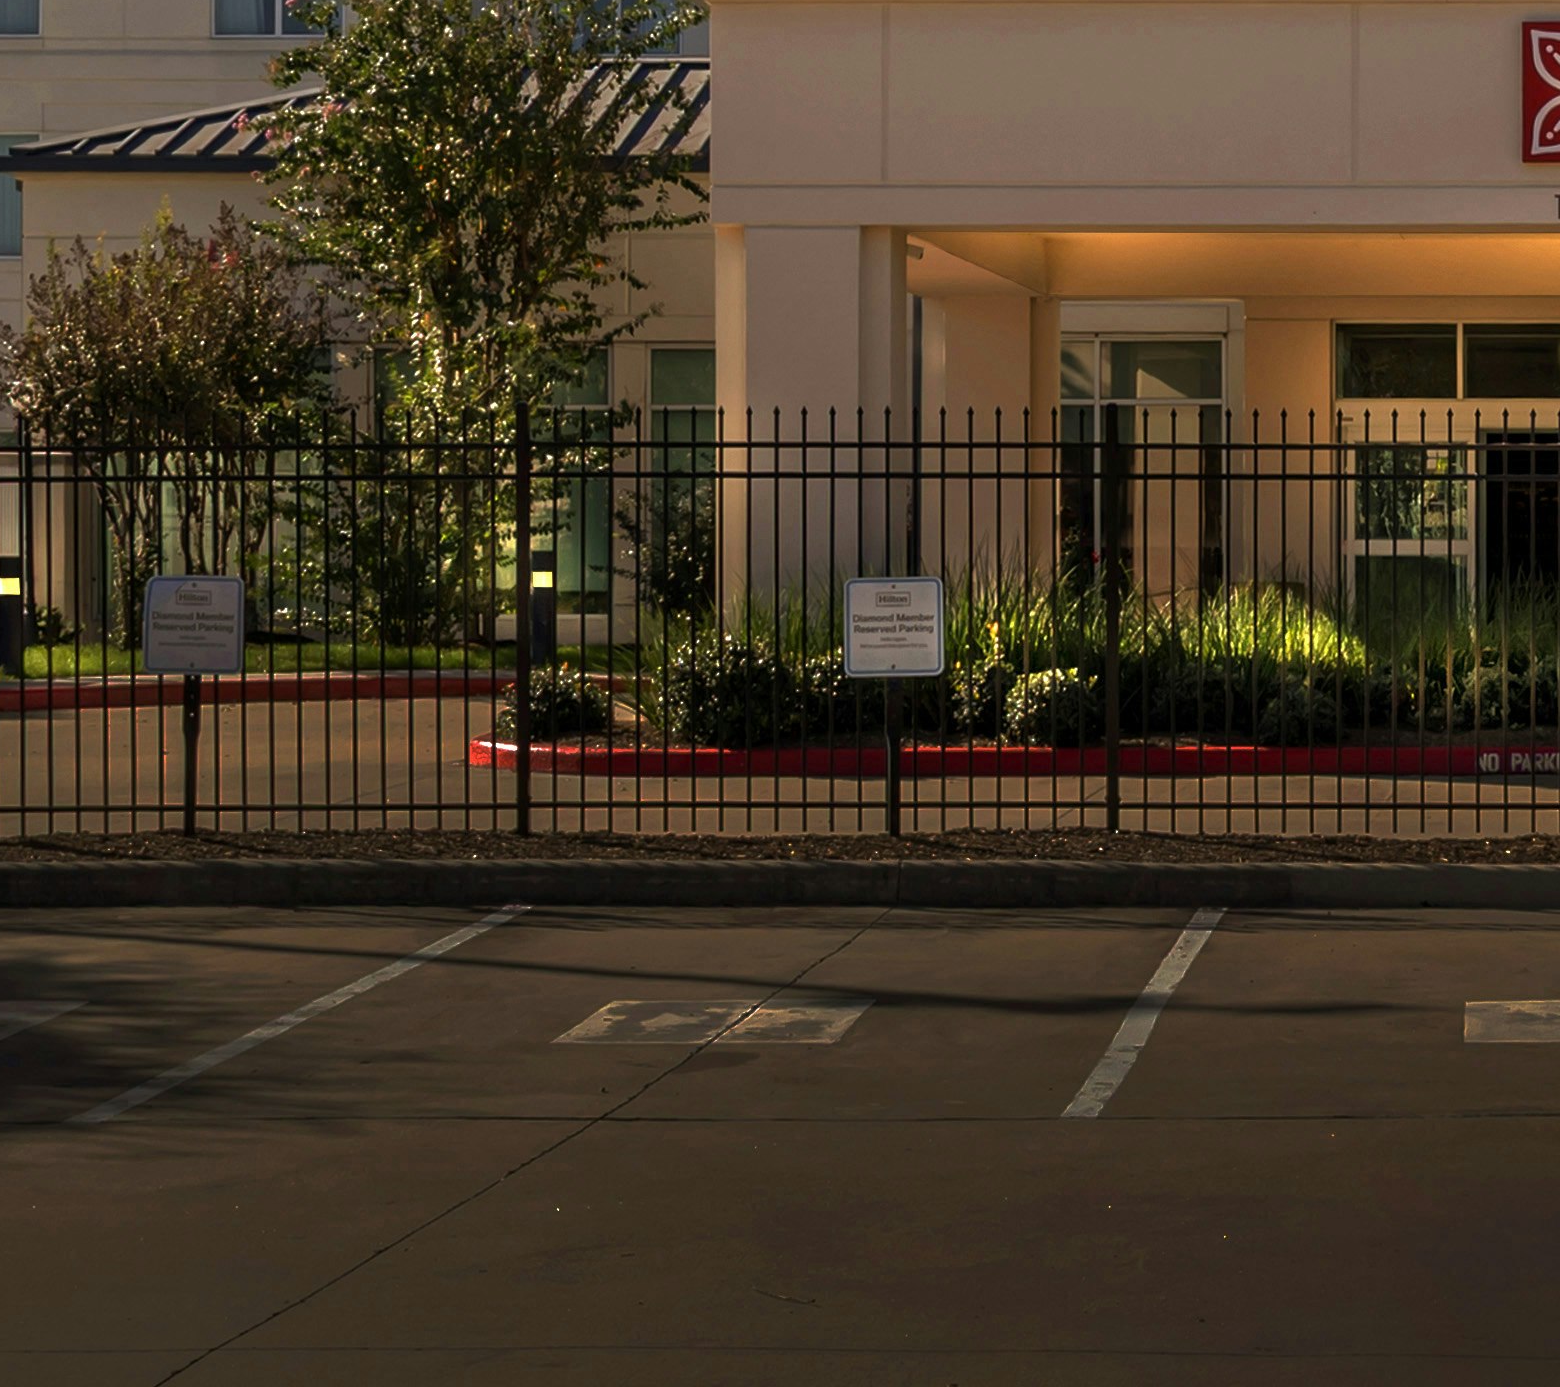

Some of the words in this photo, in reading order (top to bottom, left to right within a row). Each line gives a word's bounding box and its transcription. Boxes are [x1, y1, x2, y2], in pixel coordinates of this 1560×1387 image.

[879, 595, 907, 603] Hilton
[853, 614, 894, 623] Diamond
[854, 625, 896, 633] Reserved
[899, 624, 934, 634] Parking
